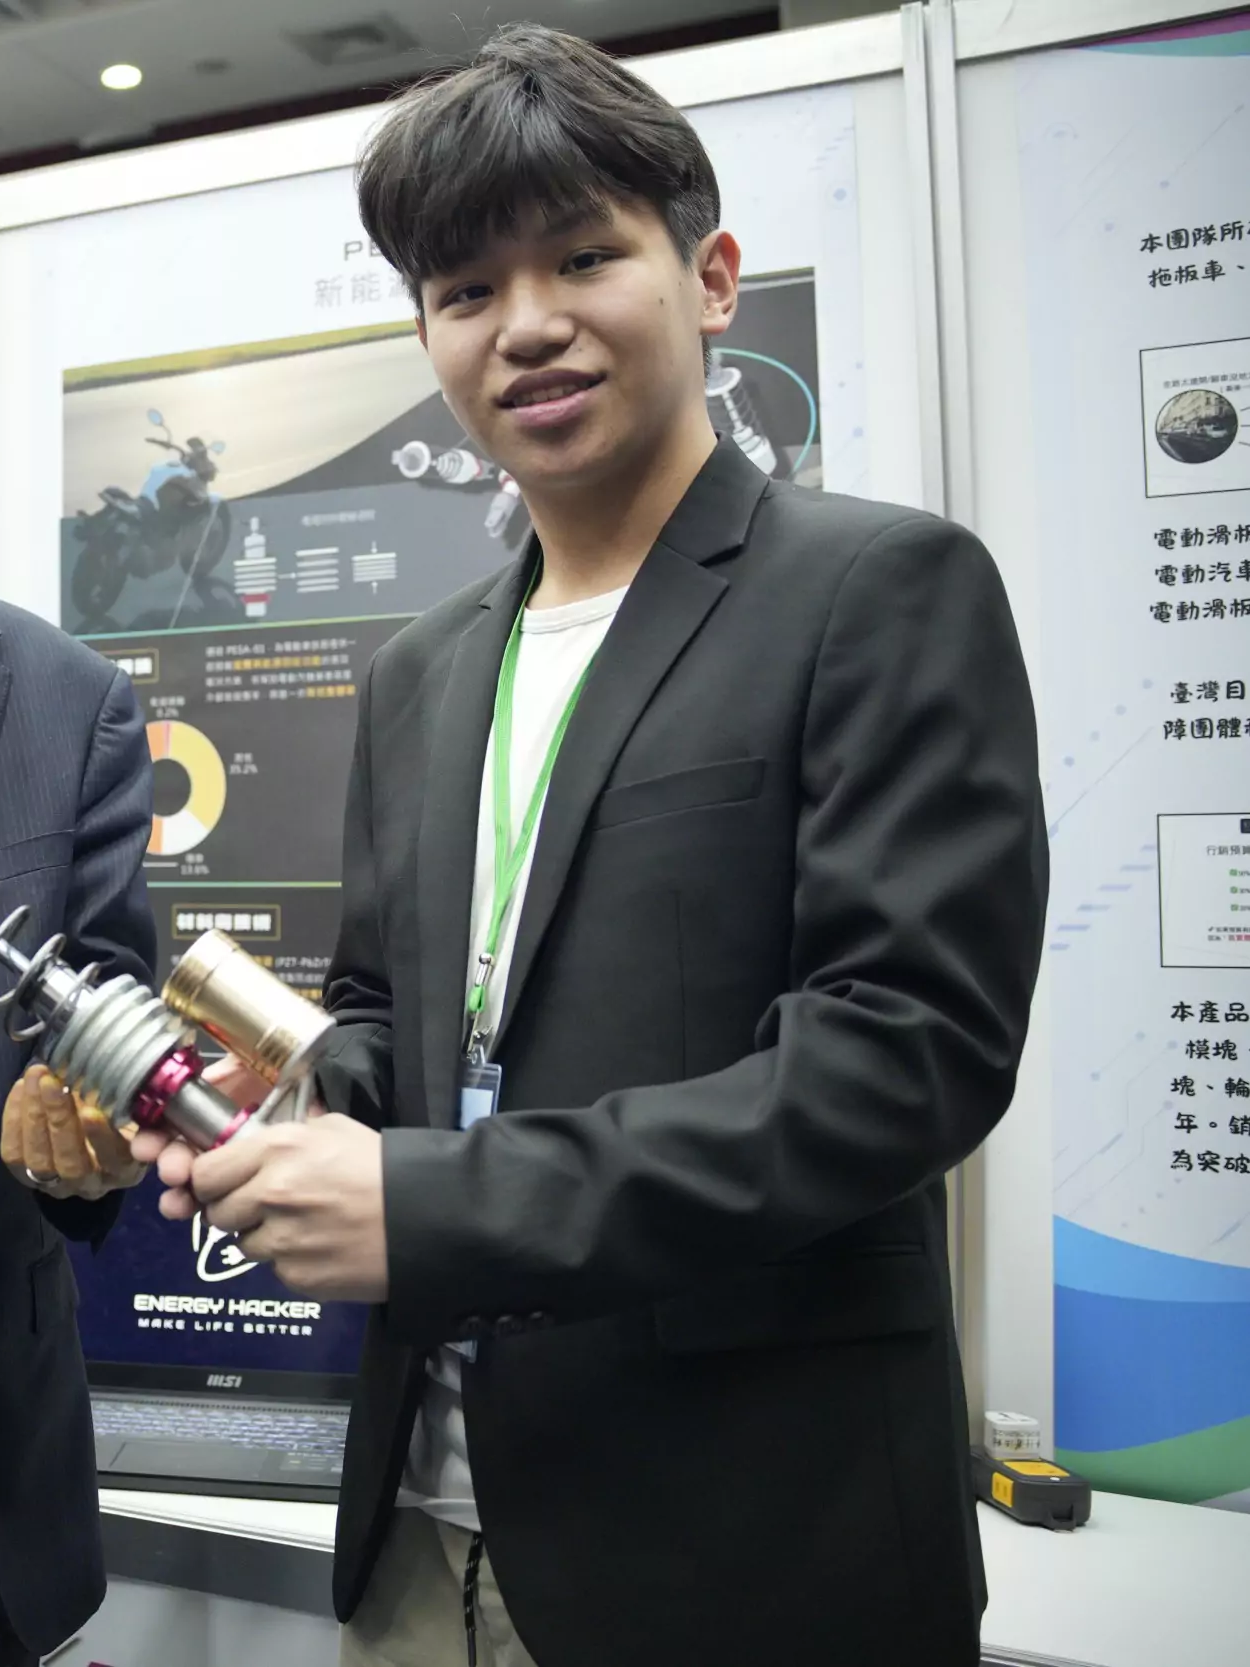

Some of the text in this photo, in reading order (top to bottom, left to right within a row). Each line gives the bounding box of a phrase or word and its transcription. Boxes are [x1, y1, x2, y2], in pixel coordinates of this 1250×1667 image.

[1140, 220, 1250, 253] 本團隊所
[1170, 680, 1245, 704] 臺灣目
[1171, 1001, 1250, 1023] 本產品
[1171, 1149, 1250, 1173] 為突破
[134, 1294, 322, 1320] ENERGY HACKER
[138, 1317, 313, 1337] MAKE LIFE BETTER
